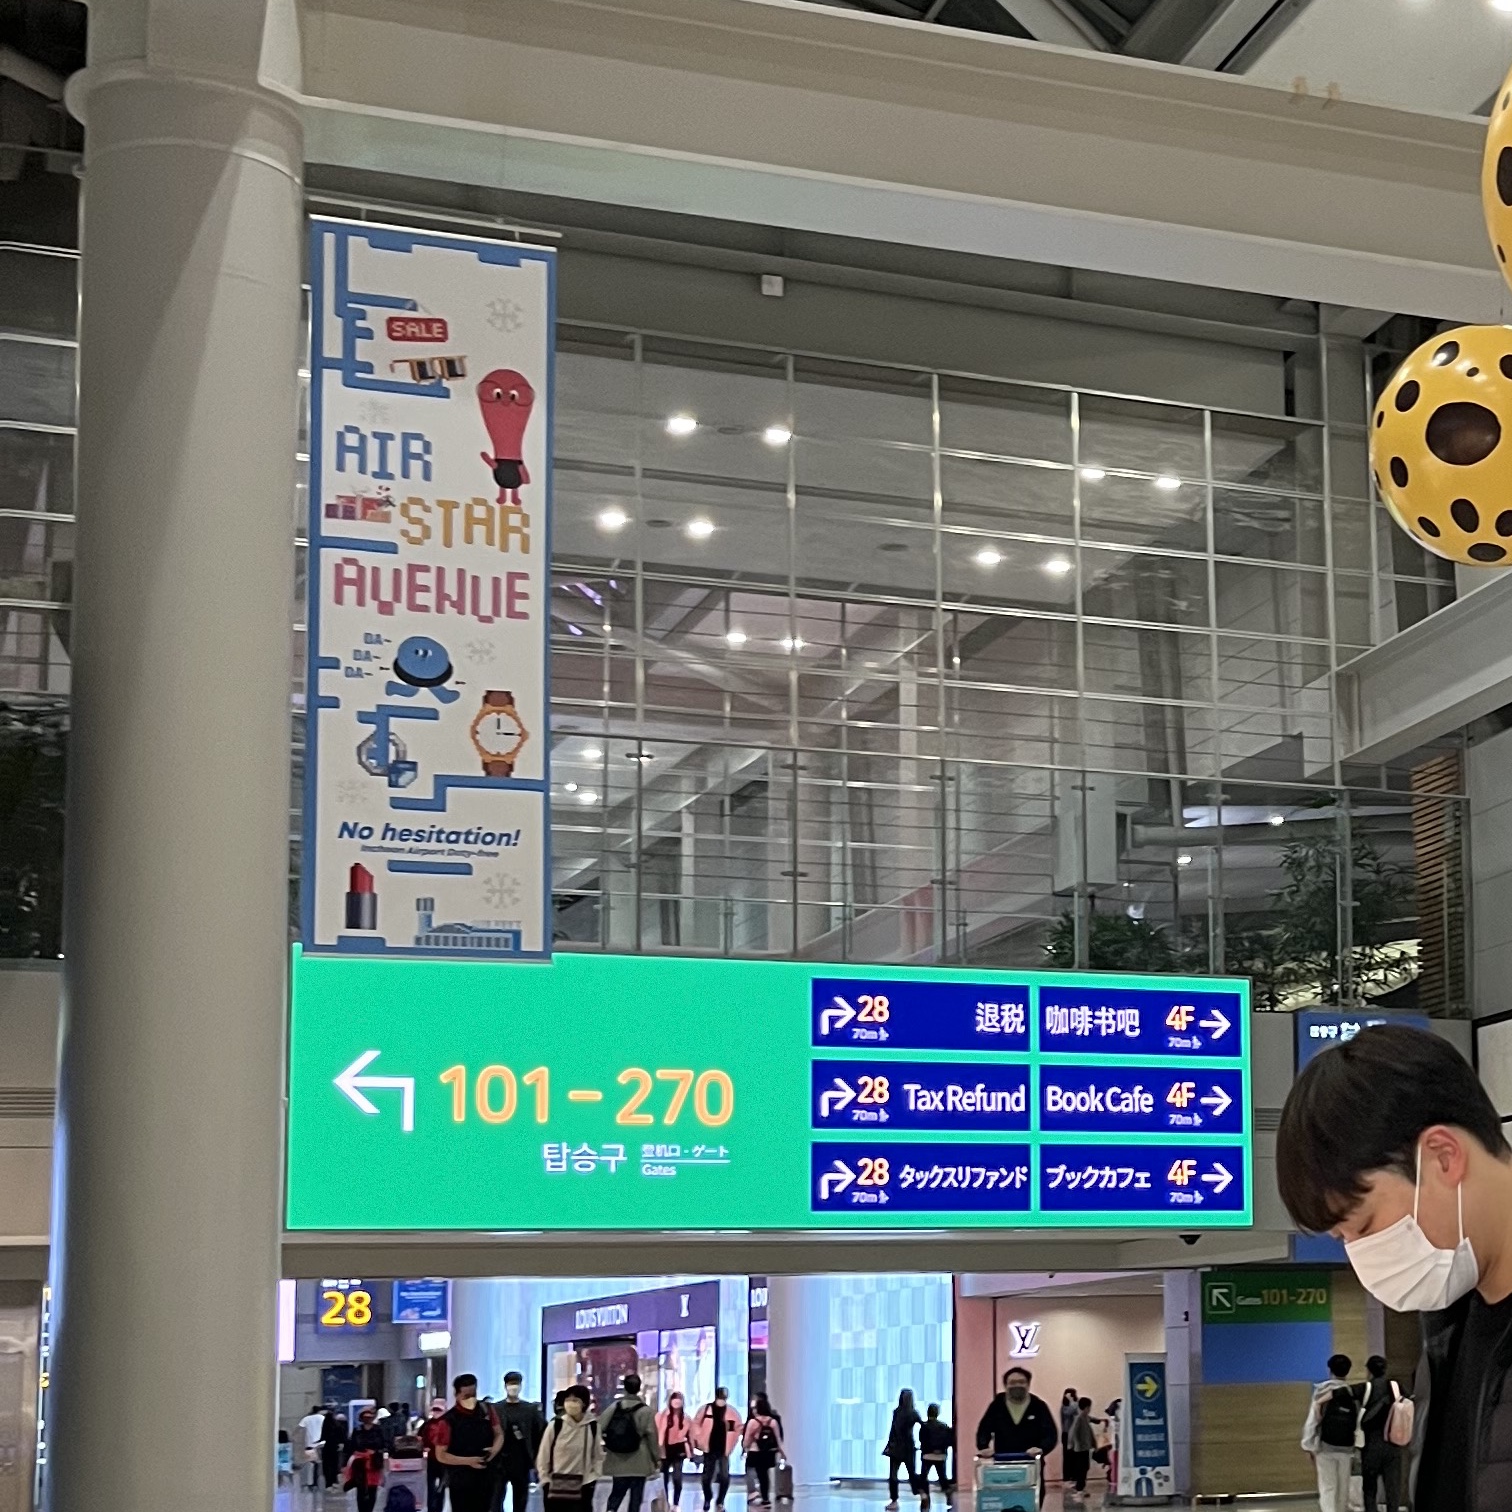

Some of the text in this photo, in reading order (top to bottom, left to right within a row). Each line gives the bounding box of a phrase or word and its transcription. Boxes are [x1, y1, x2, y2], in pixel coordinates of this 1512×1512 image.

[391, 321, 445, 338] SALE
[335, 425, 433, 481] AIR
[400, 497, 530, 554] STAR
[334, 557, 530, 623] AVENUE
[338, 821, 521, 846] No hesitation!
[857, 995, 1026, 1034] 28 退税
[1045, 1004, 1194, 1036] 咖啡书吧 4F
[857, 1076, 1026, 1112] 28 Tax Refund
[1046, 1082, 1195, 1113] Book Cafe 4F
[543, 1142, 628, 1173] 탑승구
[642, 1163, 676, 1176] Gates
[857, 1157, 1028, 1190] 28 タックスリファンド
[1046, 1159, 1197, 1190] ブックカフェ 4F
[321, 1290, 372, 1327] 28
